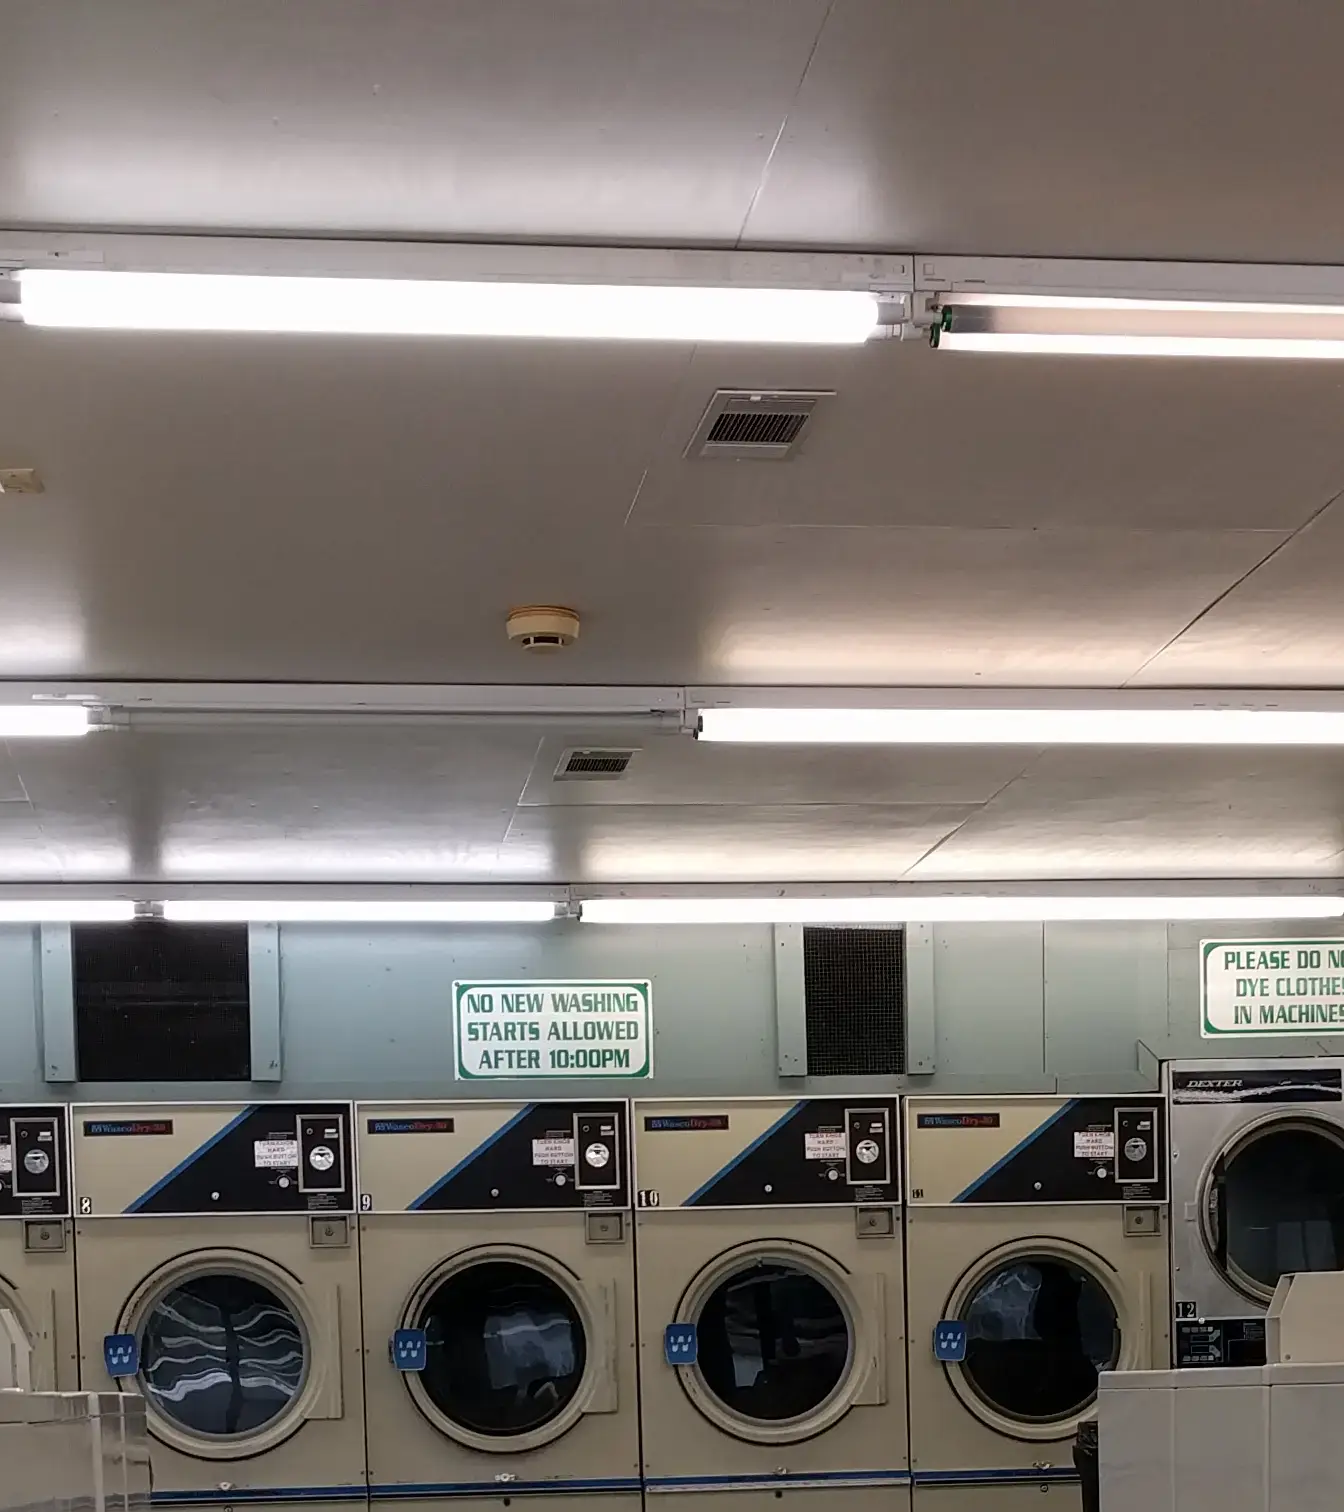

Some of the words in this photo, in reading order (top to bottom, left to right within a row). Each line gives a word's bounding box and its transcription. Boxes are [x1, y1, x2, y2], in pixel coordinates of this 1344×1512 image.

[1224, 950, 1290, 970] PLEASE
[1297, 950, 1321, 969] DO
[1235, 977, 1269, 997] DYE
[467, 993, 494, 1013] NO
[501, 993, 544, 1013] NEW
[550, 993, 639, 1013] WASHING
[1233, 1004, 1252, 1025] IN
[467, 1021, 540, 1041] STARTS
[547, 1021, 639, 1041] ALLOWED
[479, 1049, 541, 1069] AFTER
[549, 1048, 630, 1069] 10:00PM
[1186, 1079, 1243, 1088] DEXTER
[81, 1197, 91, 1214] 8
[361, 1194, 371, 1211] 9
[639, 1190, 658, 1207] 10
[1177, 1302, 1195, 1318] 12
